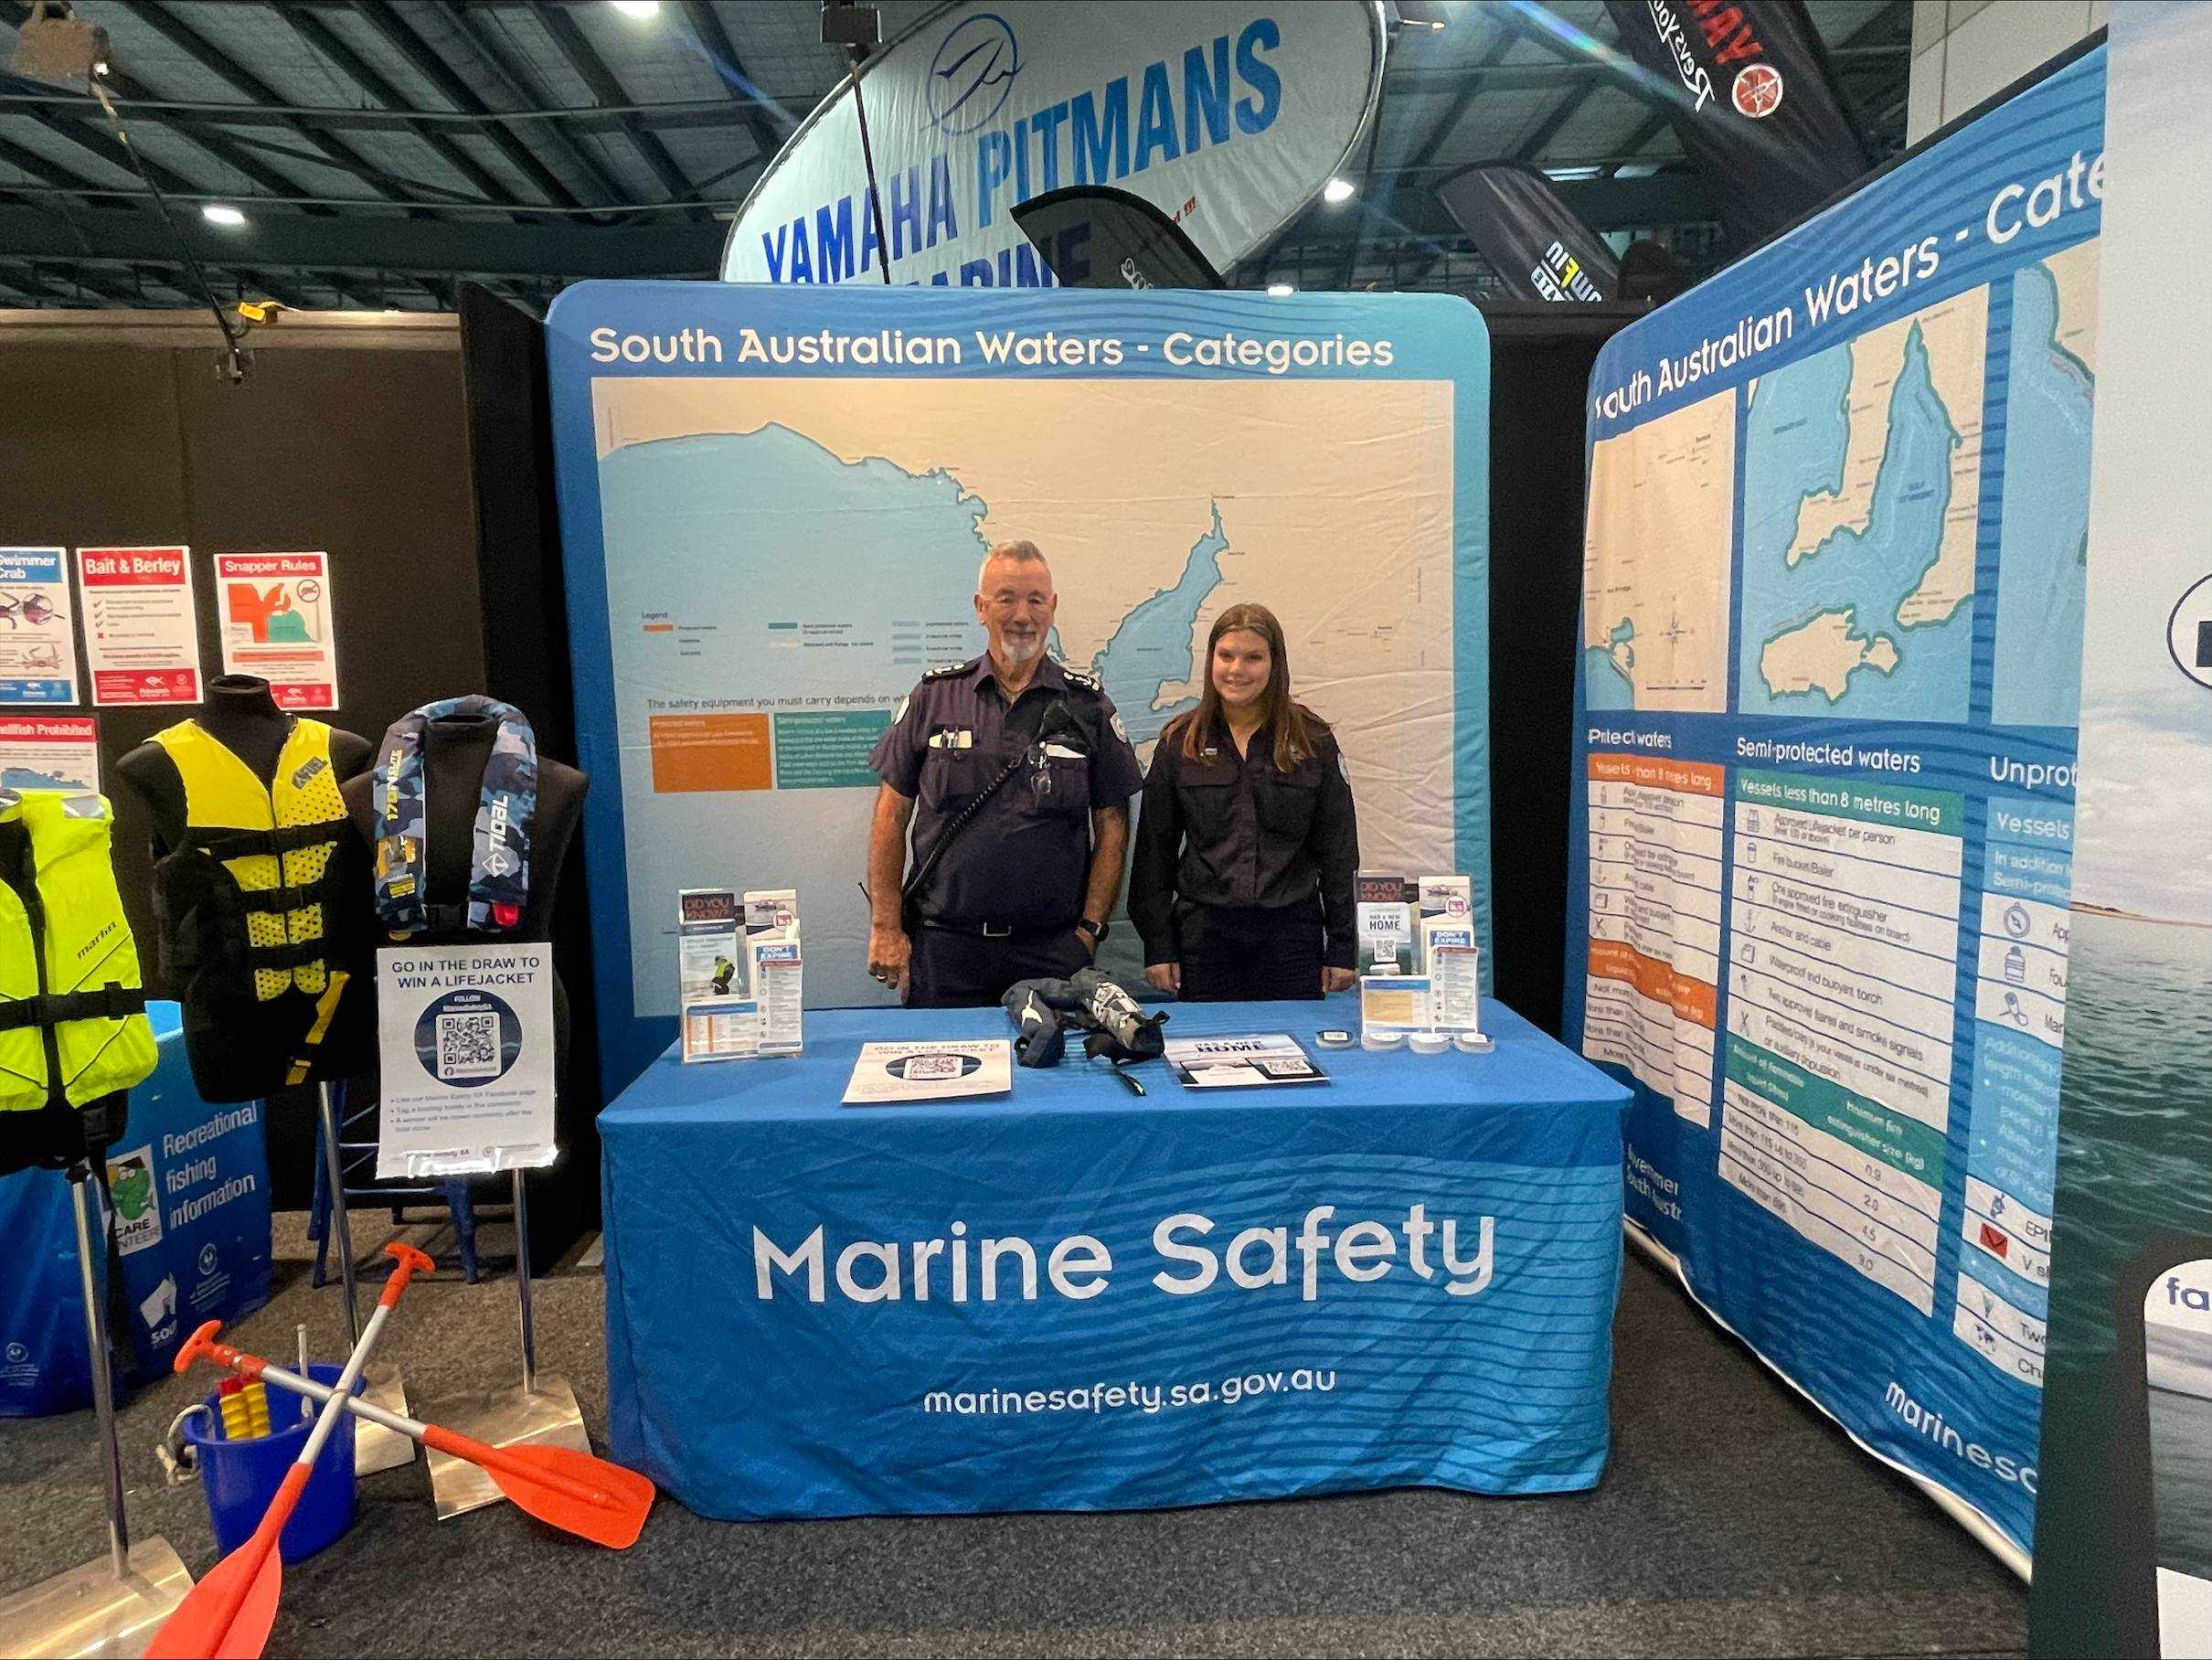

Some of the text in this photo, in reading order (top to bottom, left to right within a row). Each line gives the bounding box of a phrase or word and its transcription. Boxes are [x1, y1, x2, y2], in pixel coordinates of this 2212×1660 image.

[976, 17, 1281, 229] PITMANS
[761, 154, 958, 284] YAMAHA
[1657, 304, 1793, 399] Australian
[1803, 239, 1941, 330] Waters
[590, 326, 1394, 375] South Australian Waters - Categories
[85, 557, 181, 577] Bait & Berley
[225, 559, 316, 574] Snapper Rules
[647, 694, 891, 710] The safety equipment you must carry depends on
[37, 723, 91, 736] Prohibited
[1636, 732, 1673, 749] waters
[1737, 737, 1921, 773] Semi-protected waters
[1691, 771, 1712, 791] long
[1740, 778, 1941, 826] Vessels less than 8 metres long
[1863, 830, 1896, 846] person
[1997, 811, 2070, 840] Vessels
[1368, 920, 1401, 931] HOME
[391, 956, 540, 974] GO IN THE DRAW TO
[397, 973, 535, 989] WIN A LIFEJACKET
[1856, 988, 1884, 1006] torch
[1888, 1039, 1924, 1063] signals
[163, 1101, 259, 1158] Recreational
[166, 1155, 218, 1194] fishing
[170, 1174, 256, 1229] information
[752, 1203, 1496, 1305] Marine Safety
[923, 1367, 1337, 1415] marinesafety.sa.gov.au
